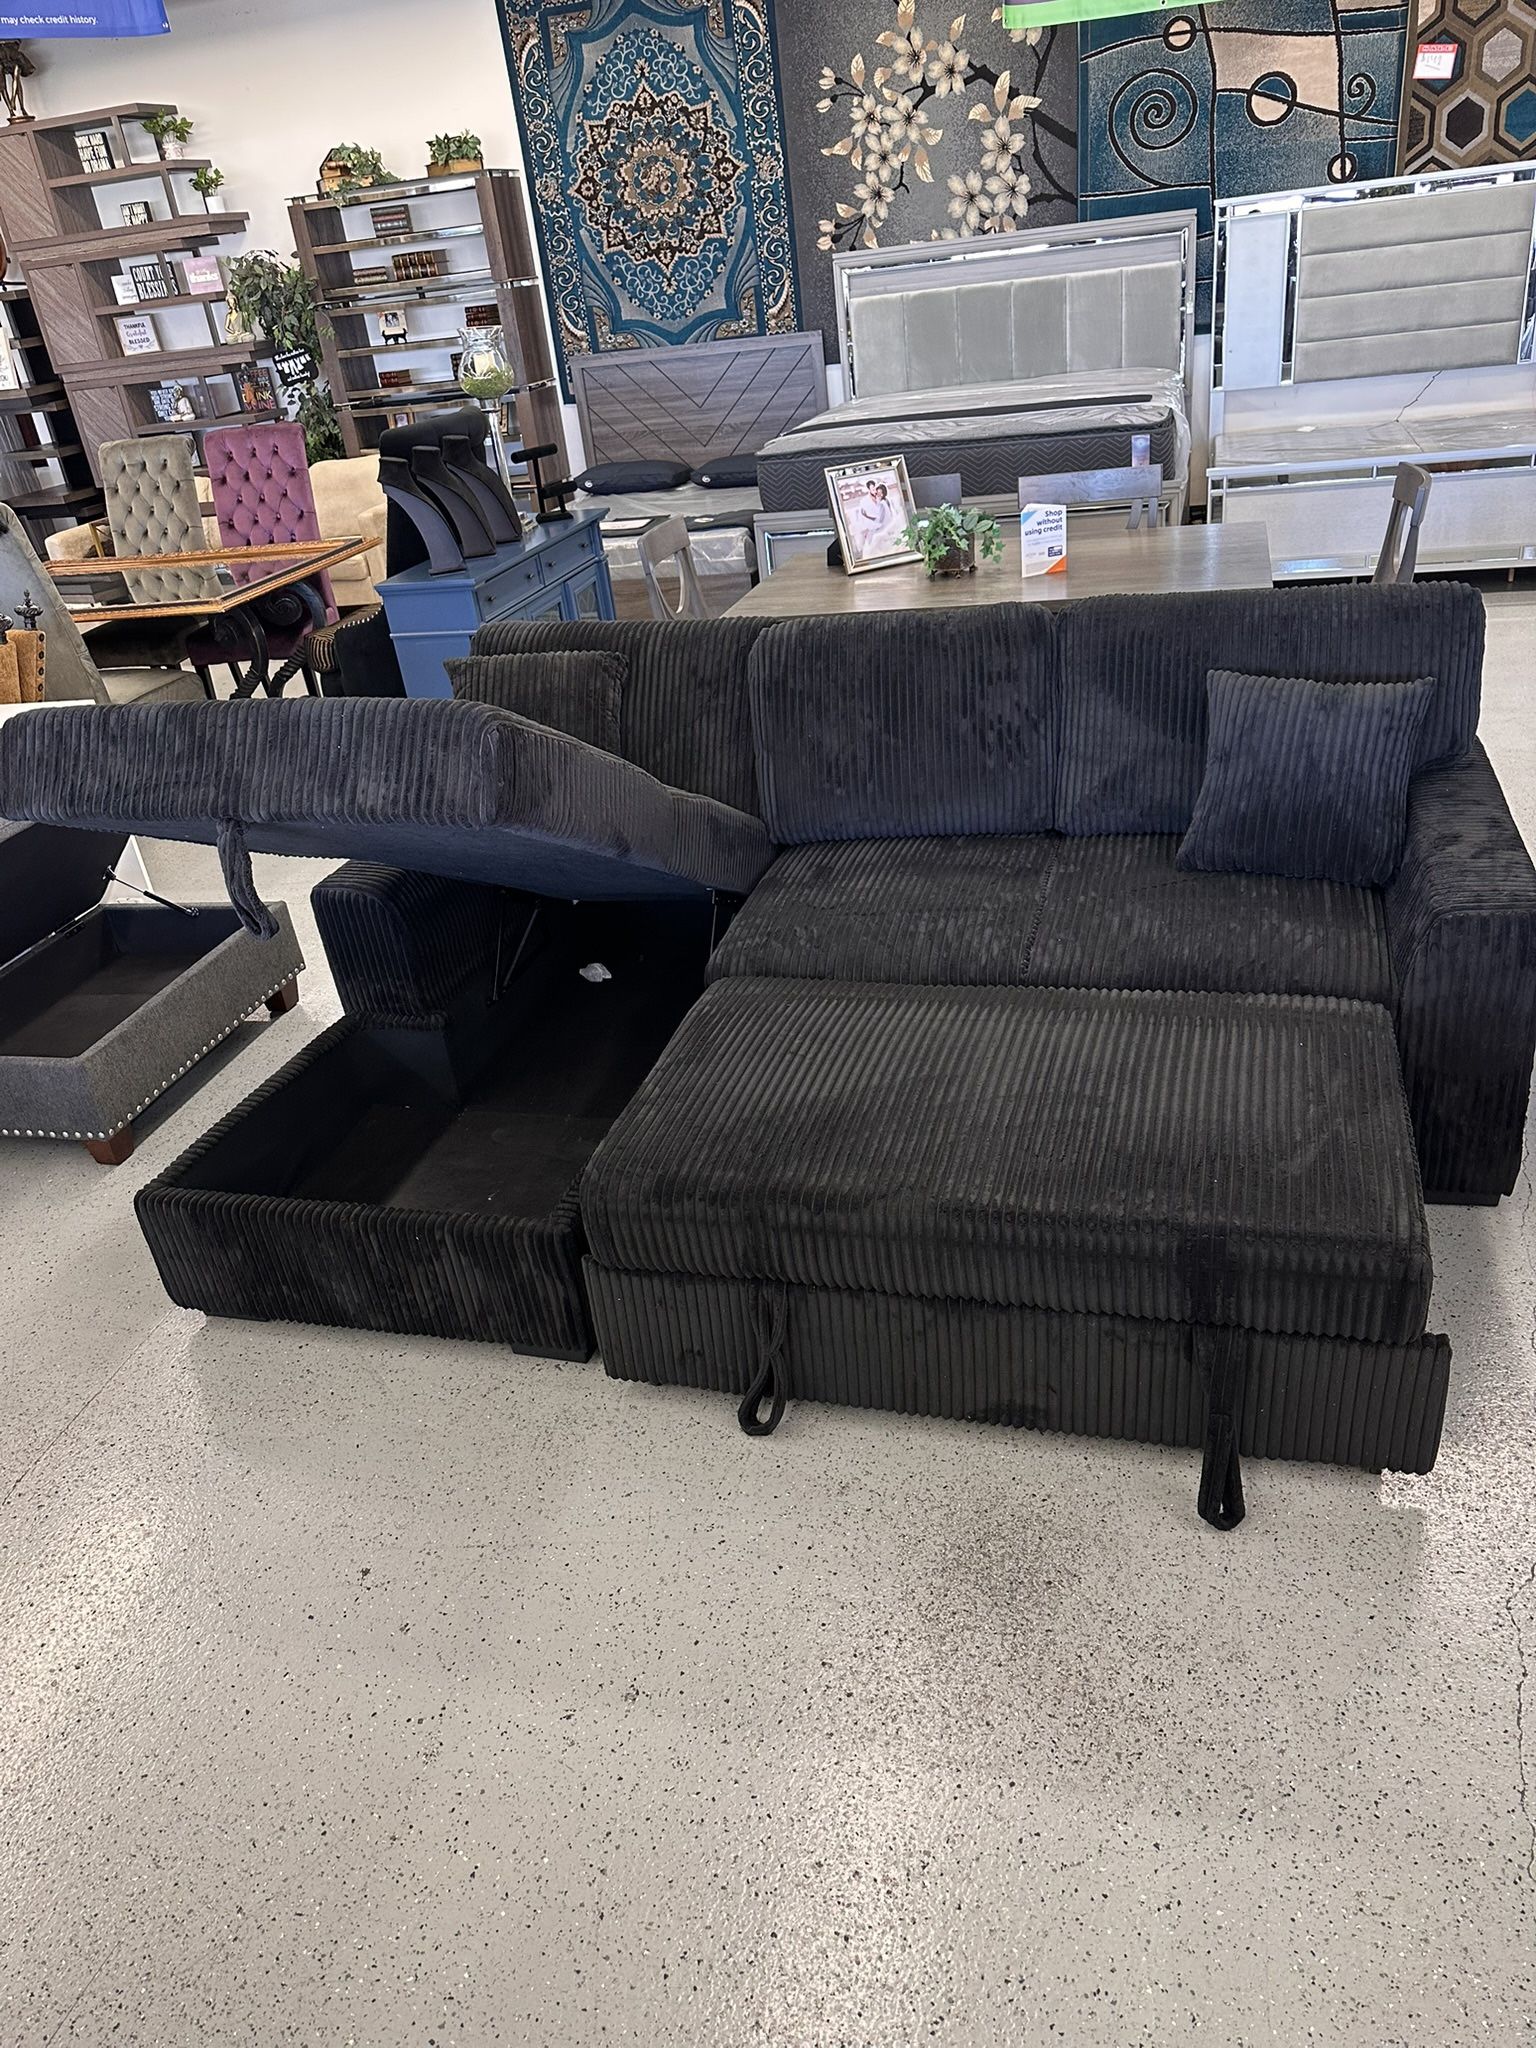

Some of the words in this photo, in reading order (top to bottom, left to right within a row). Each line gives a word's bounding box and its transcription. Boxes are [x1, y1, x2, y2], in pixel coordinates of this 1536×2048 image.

[0, 16, 18, 26] may
[20, 15, 44, 24] check
[45, 15, 69, 24] credit
[132, 265, 155, 282] COUNT
[136, 279, 179, 300] BLESSINS
[242, 390, 273, 402] DINK
[244, 400, 277, 410] WINE
[1045, 510, 1063, 518] Shop
[1037, 517, 1063, 526] without
[1024, 526, 1042, 536] using
[1043, 525, 1063, 533] credit
